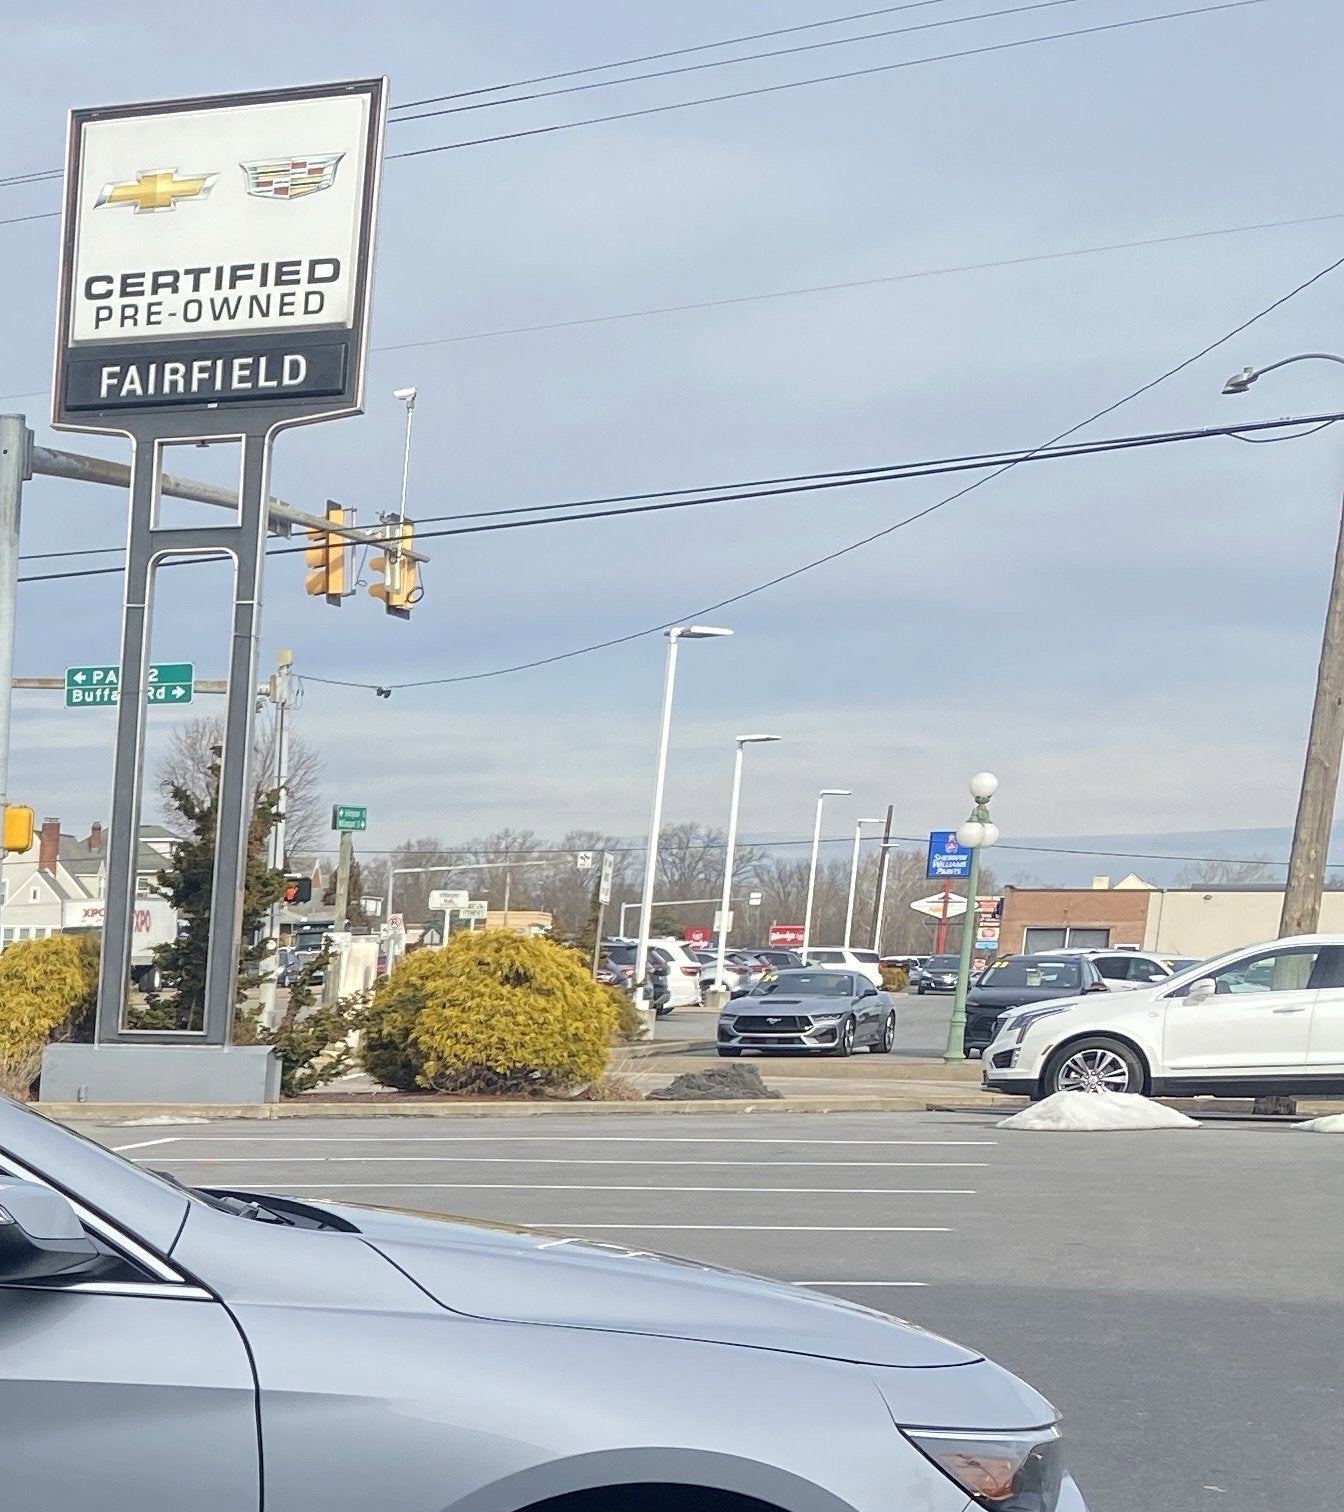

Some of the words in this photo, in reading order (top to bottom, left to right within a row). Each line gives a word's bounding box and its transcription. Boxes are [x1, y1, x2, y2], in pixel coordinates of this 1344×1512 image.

[84, 257, 341, 301] CERTIFIED
[94, 290, 325, 331] PRE-OWNED
[99, 353, 307, 399] FAIRFIELD
[72, 688, 120, 702] Buffa
[92, 670, 118, 684] PA
